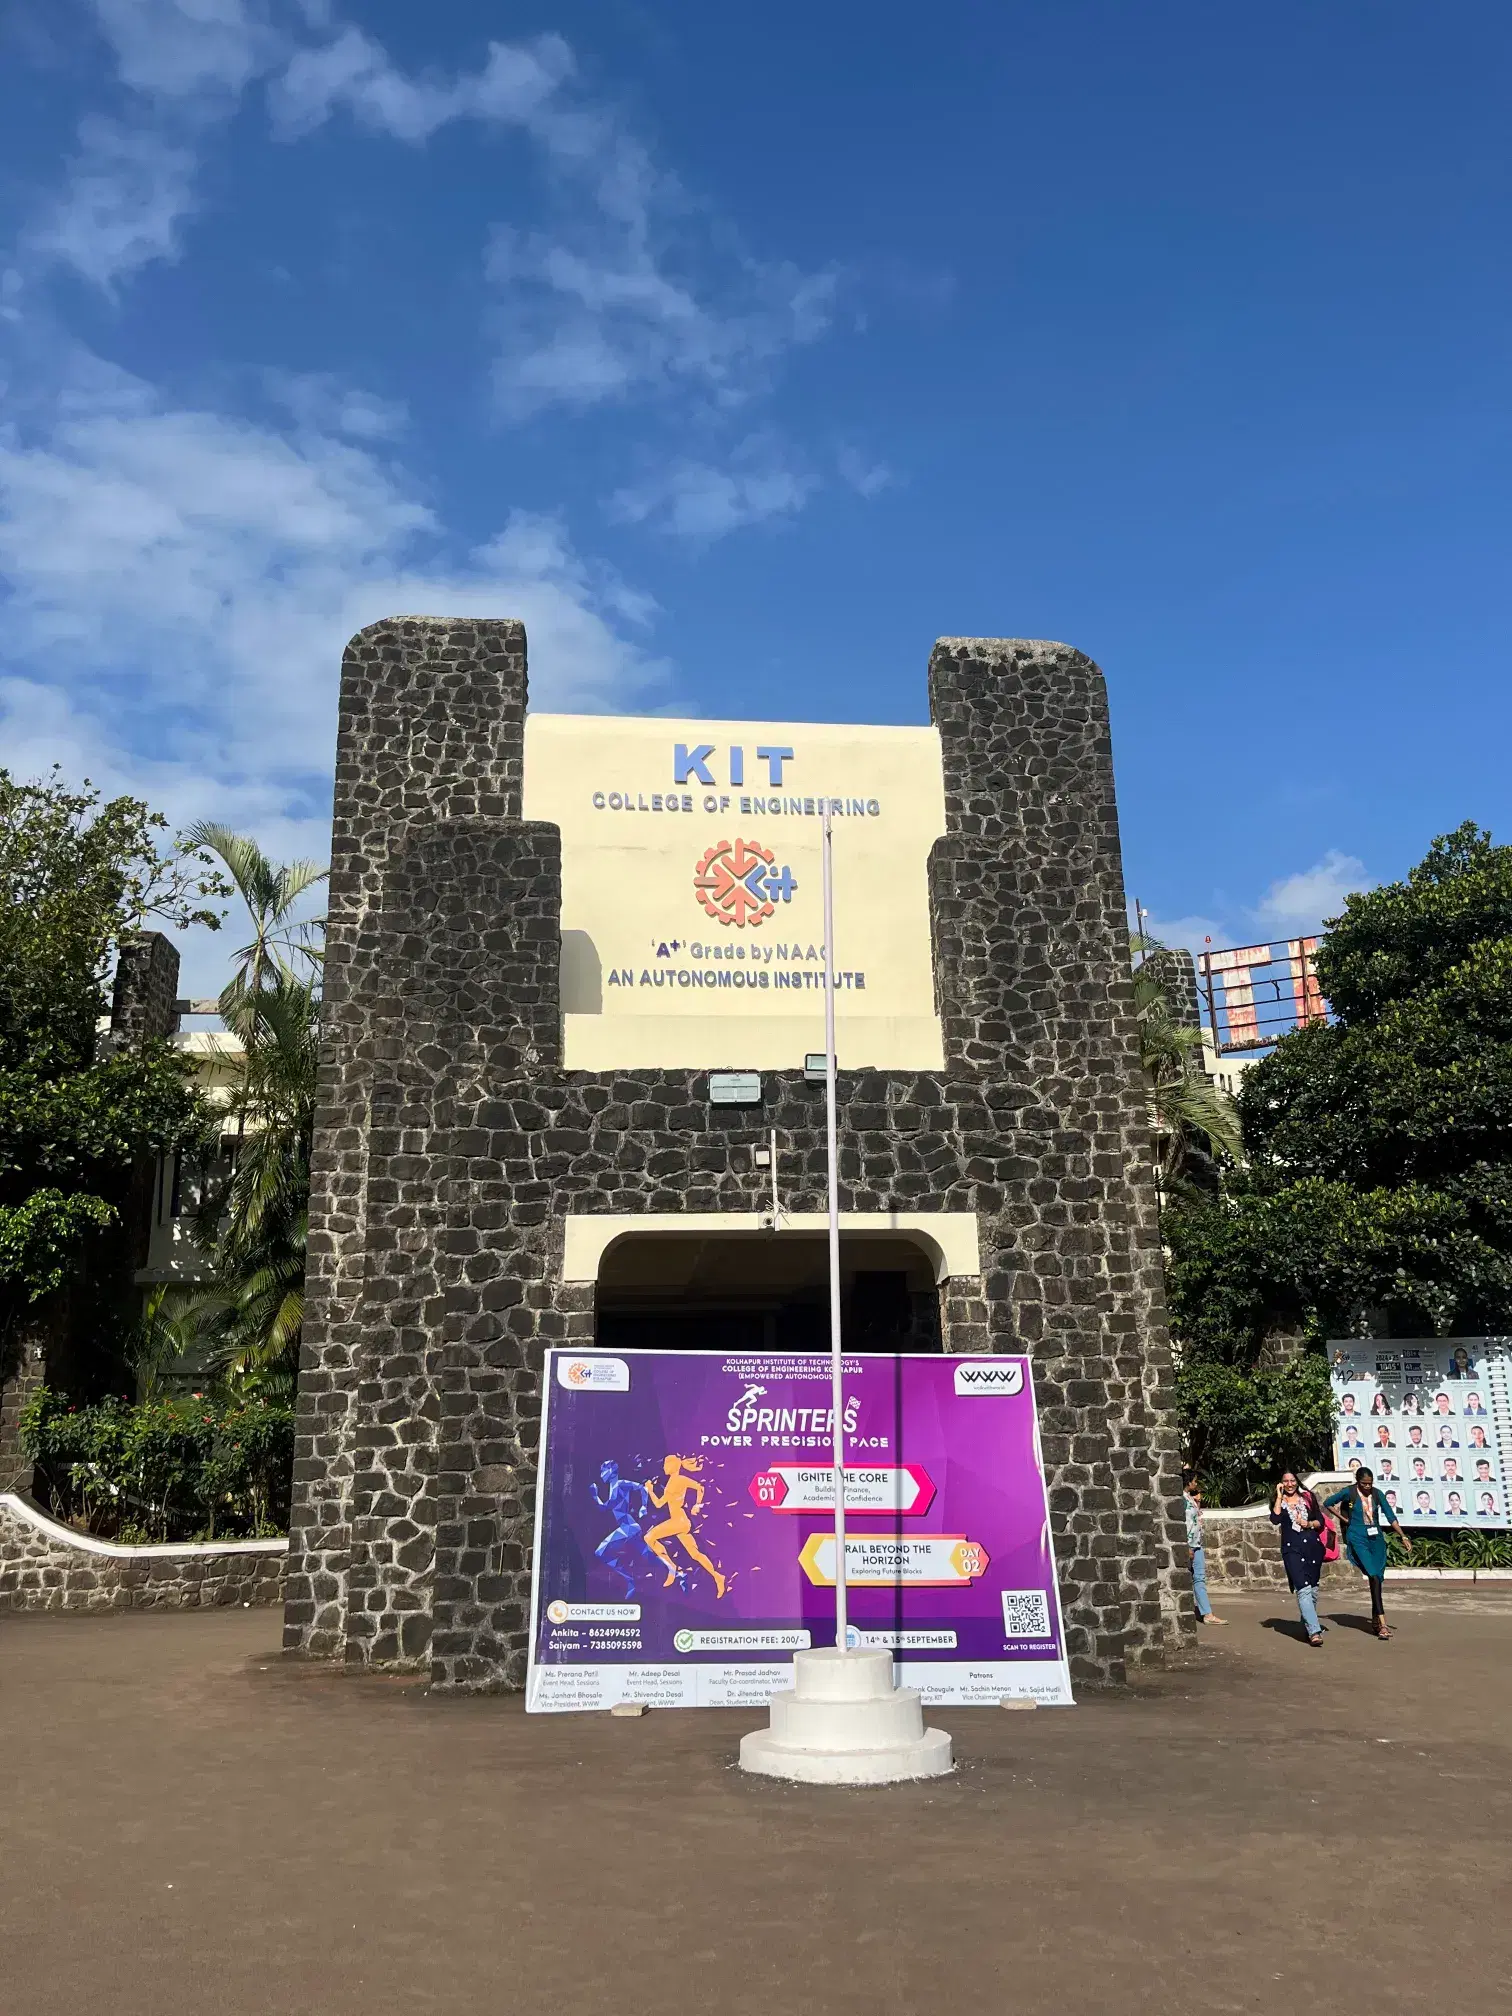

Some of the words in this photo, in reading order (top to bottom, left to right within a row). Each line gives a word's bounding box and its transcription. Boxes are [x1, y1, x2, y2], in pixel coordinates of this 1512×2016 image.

[674, 744, 794, 786] KIT
[592, 792, 693, 812] COLLEGE
[704, 796, 730, 814] OF
[740, 797, 880, 816] ENGINEERING
[691, 942, 745, 960] Grade
[751, 944, 773, 963] by
[608, 970, 634, 987] AN
[640, 970, 769, 988] AUTONOMOUS
[774, 972, 865, 989] INSTITUTE
[701, 1436, 753, 1446] POWER
[850, 1437, 889, 1447] PACE
[758, 1477, 777, 1486] DAY
[798, 1473, 832, 1482] IGNITE
[859, 1474, 888, 1483] CORE
[759, 1488, 775, 1501] 01
[870, 1545, 910, 1553] BEYOND
[913, 1545, 931, 1553] THE
[960, 1548, 980, 1558] DAY
[862, 1556, 909, 1564] HORIZON
[962, 1560, 980, 1573] 02
[551, 1629, 579, 1637] Ankita
[589, 1629, 640, 1637] 8624994592
[781, 1636, 804, 1644] 200/-
[907, 1636, 953, 1644] SEPTEMBER
[549, 1641, 580, 1651] Saiyam
[590, 1641, 642, 1649] 7385095598
